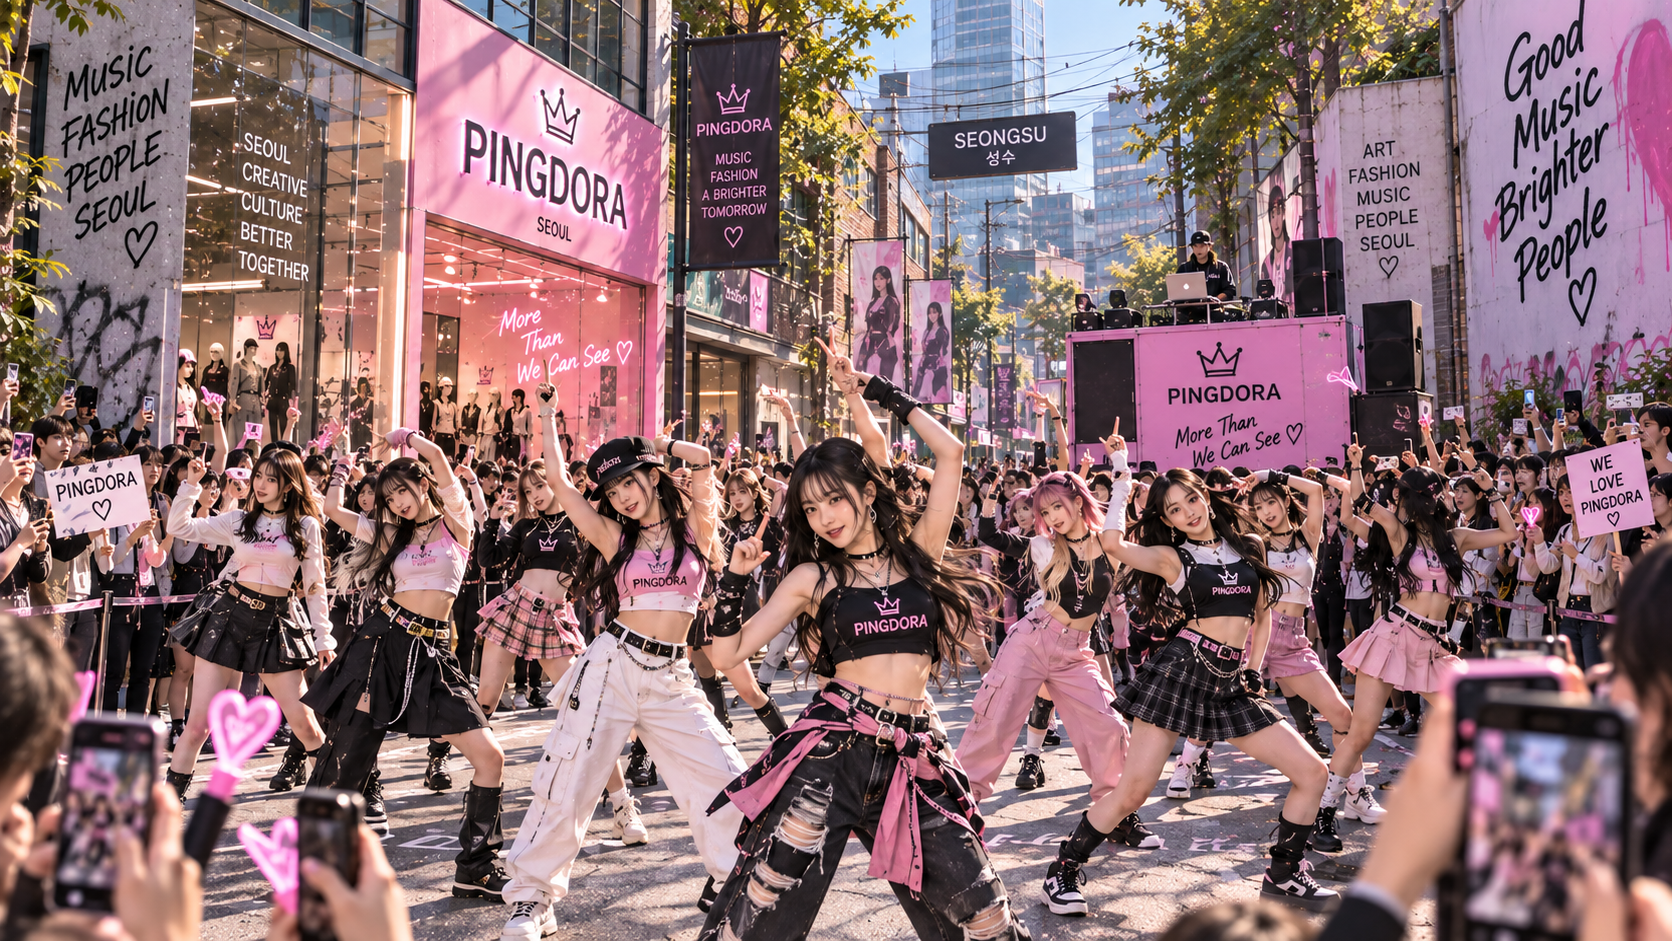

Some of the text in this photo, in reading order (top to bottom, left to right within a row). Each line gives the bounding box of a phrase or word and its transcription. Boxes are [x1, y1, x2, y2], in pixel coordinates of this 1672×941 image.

[1504, 0, 1585, 102] Good
[696, 117, 773, 137] PINGDORA
[1513, 67, 1603, 169] Music
[244, 132, 291, 165] SEOUL
[954, 126, 1046, 146] SEONGSU
[715, 151, 752, 166] MUSIC
[986, 149, 1015, 166] 성수
[1363, 140, 1396, 159] ART
[64, 130, 162, 203] PEOPLE
[242, 162, 308, 197] CREATIVE
[463, 119, 627, 230] PINGDORA
[710, 168, 758, 183] FASHION
[1349, 161, 1420, 184] FASHION
[702, 185, 767, 200] A BRIGHTER
[1495, 122, 1609, 242] Brighter
[241, 192, 303, 224] CULTURE
[1356, 186, 1411, 206] MUSIC
[75, 181, 156, 240] SEOUL
[701, 202, 767, 219] TOMORROW
[1355, 208, 1419, 230] PEOPLE
[240, 222, 293, 251] BETTER
[537, 216, 572, 242] SEOUL
[1360, 231, 1415, 252] SEOUL
[1514, 186, 1607, 304] People
[239, 250, 309, 282] TOGETHER
[499, 307, 542, 337] More
[520, 328, 564, 355] Than
[517, 345, 610, 384] We Can See
[1168, 383, 1281, 405] PINGDORA
[1175, 413, 1258, 449] More Than
[1193, 431, 1281, 468] We Can See
[1590, 454, 1614, 473] WE
[55, 470, 138, 502] PINGDORA
[1590, 472, 1624, 494] LOVE
[1580, 490, 1644, 515] PINGDORA
[632, 575, 688, 590] PINGDORA
[853, 613, 928, 637] PINGDORA
